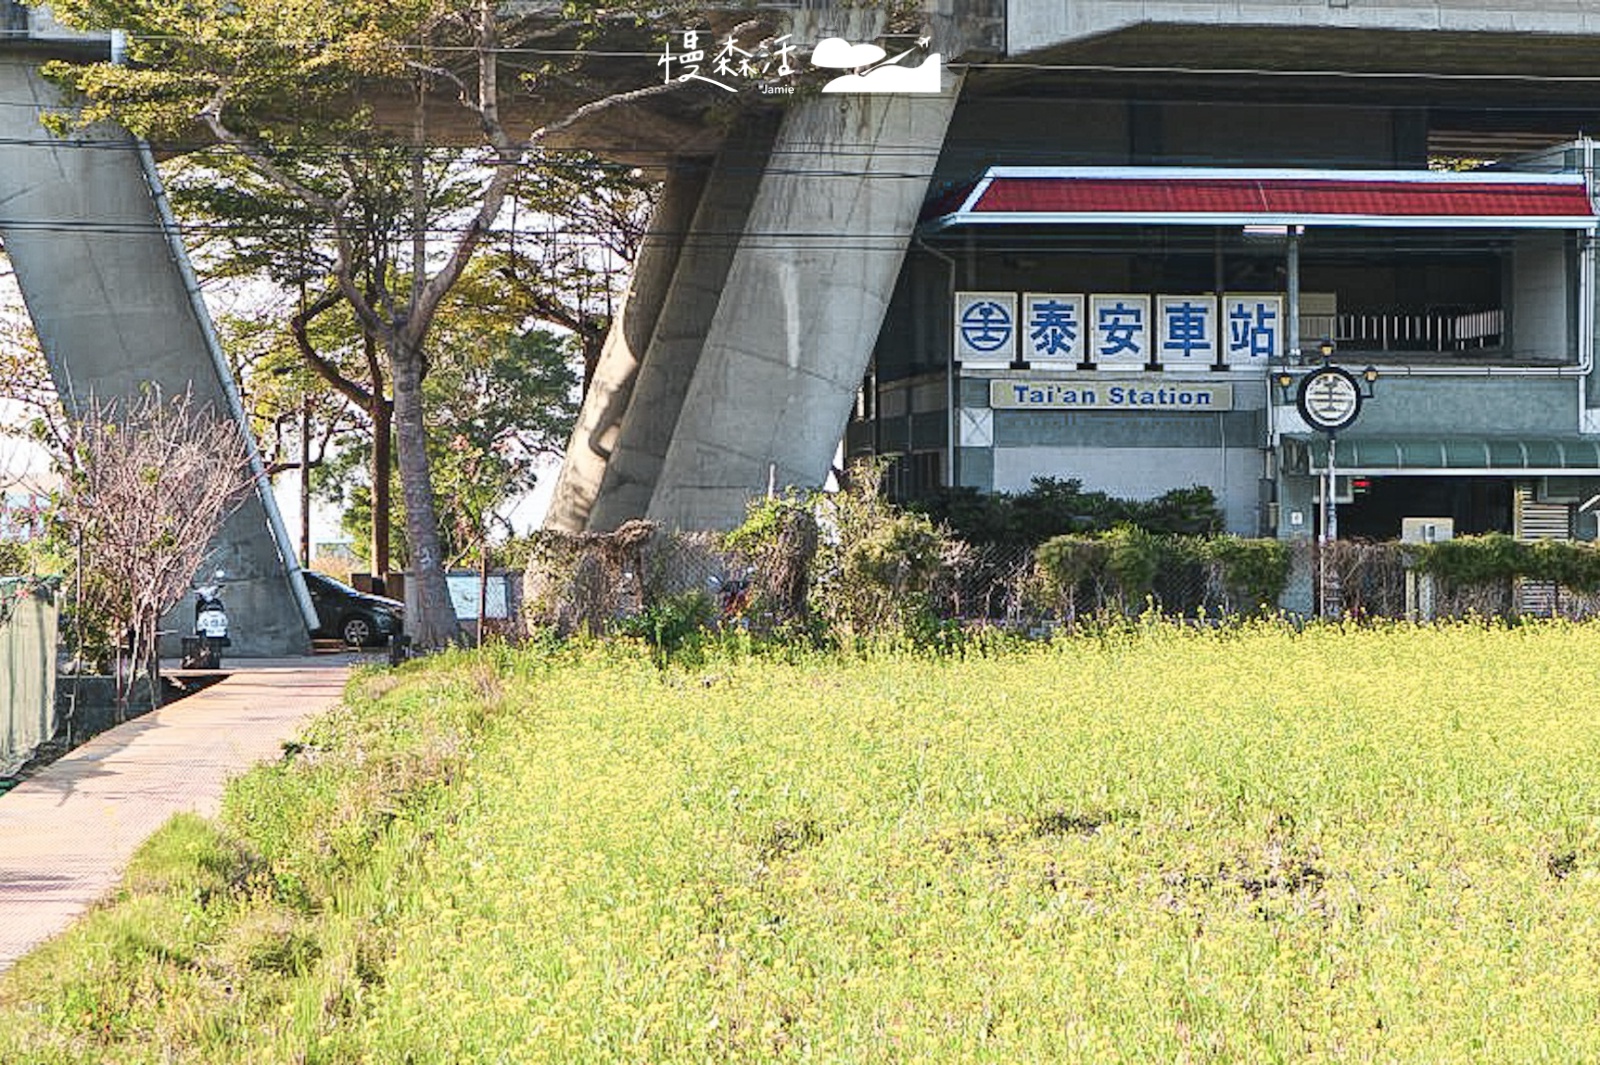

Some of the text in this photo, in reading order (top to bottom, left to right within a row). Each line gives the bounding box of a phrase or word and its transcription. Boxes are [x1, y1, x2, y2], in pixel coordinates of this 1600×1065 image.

[1030, 300, 1276, 357] 泰安車站
[1013, 385, 1212, 405] Tai'an Station
